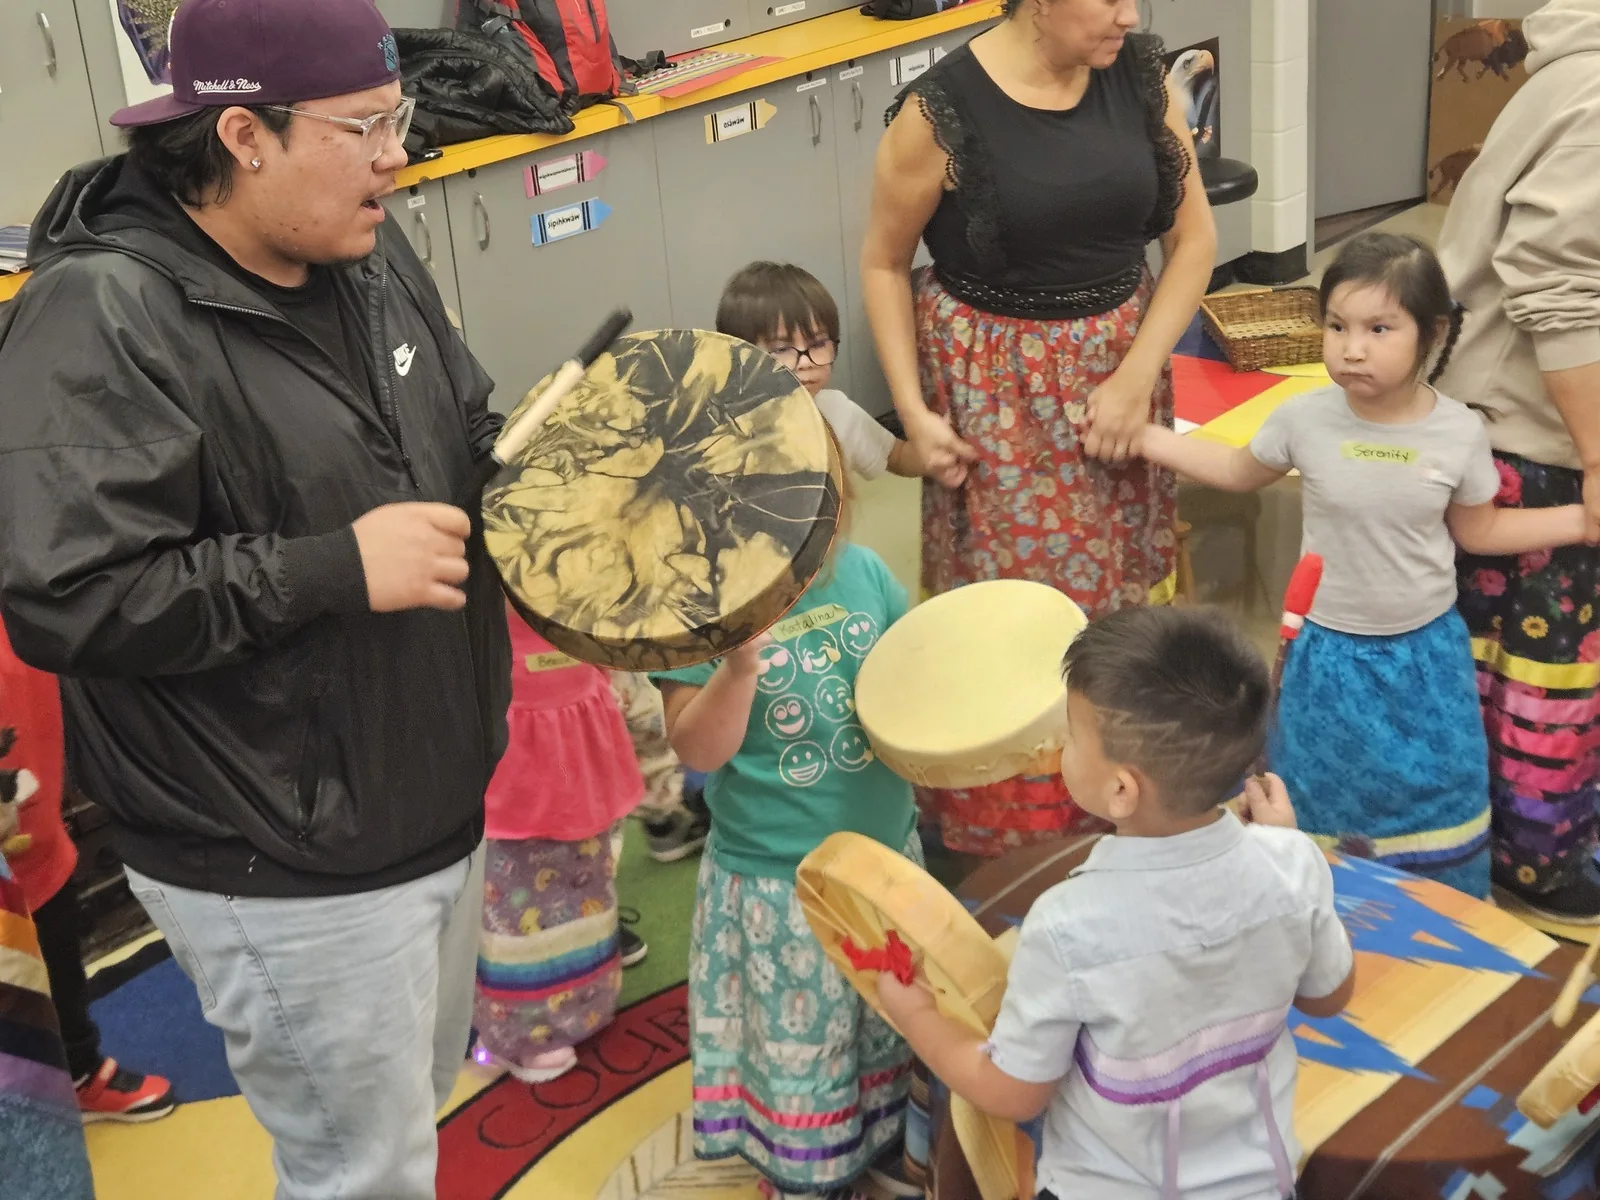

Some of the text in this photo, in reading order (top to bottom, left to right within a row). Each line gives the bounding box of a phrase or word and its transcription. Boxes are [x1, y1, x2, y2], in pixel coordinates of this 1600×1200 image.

[193, 77, 261, 91] Mitchell & Ness
[392, 342, 410, 366] NIKE
[1353, 445, 1409, 463] Serenity
[778, 609, 835, 637] Katalina
